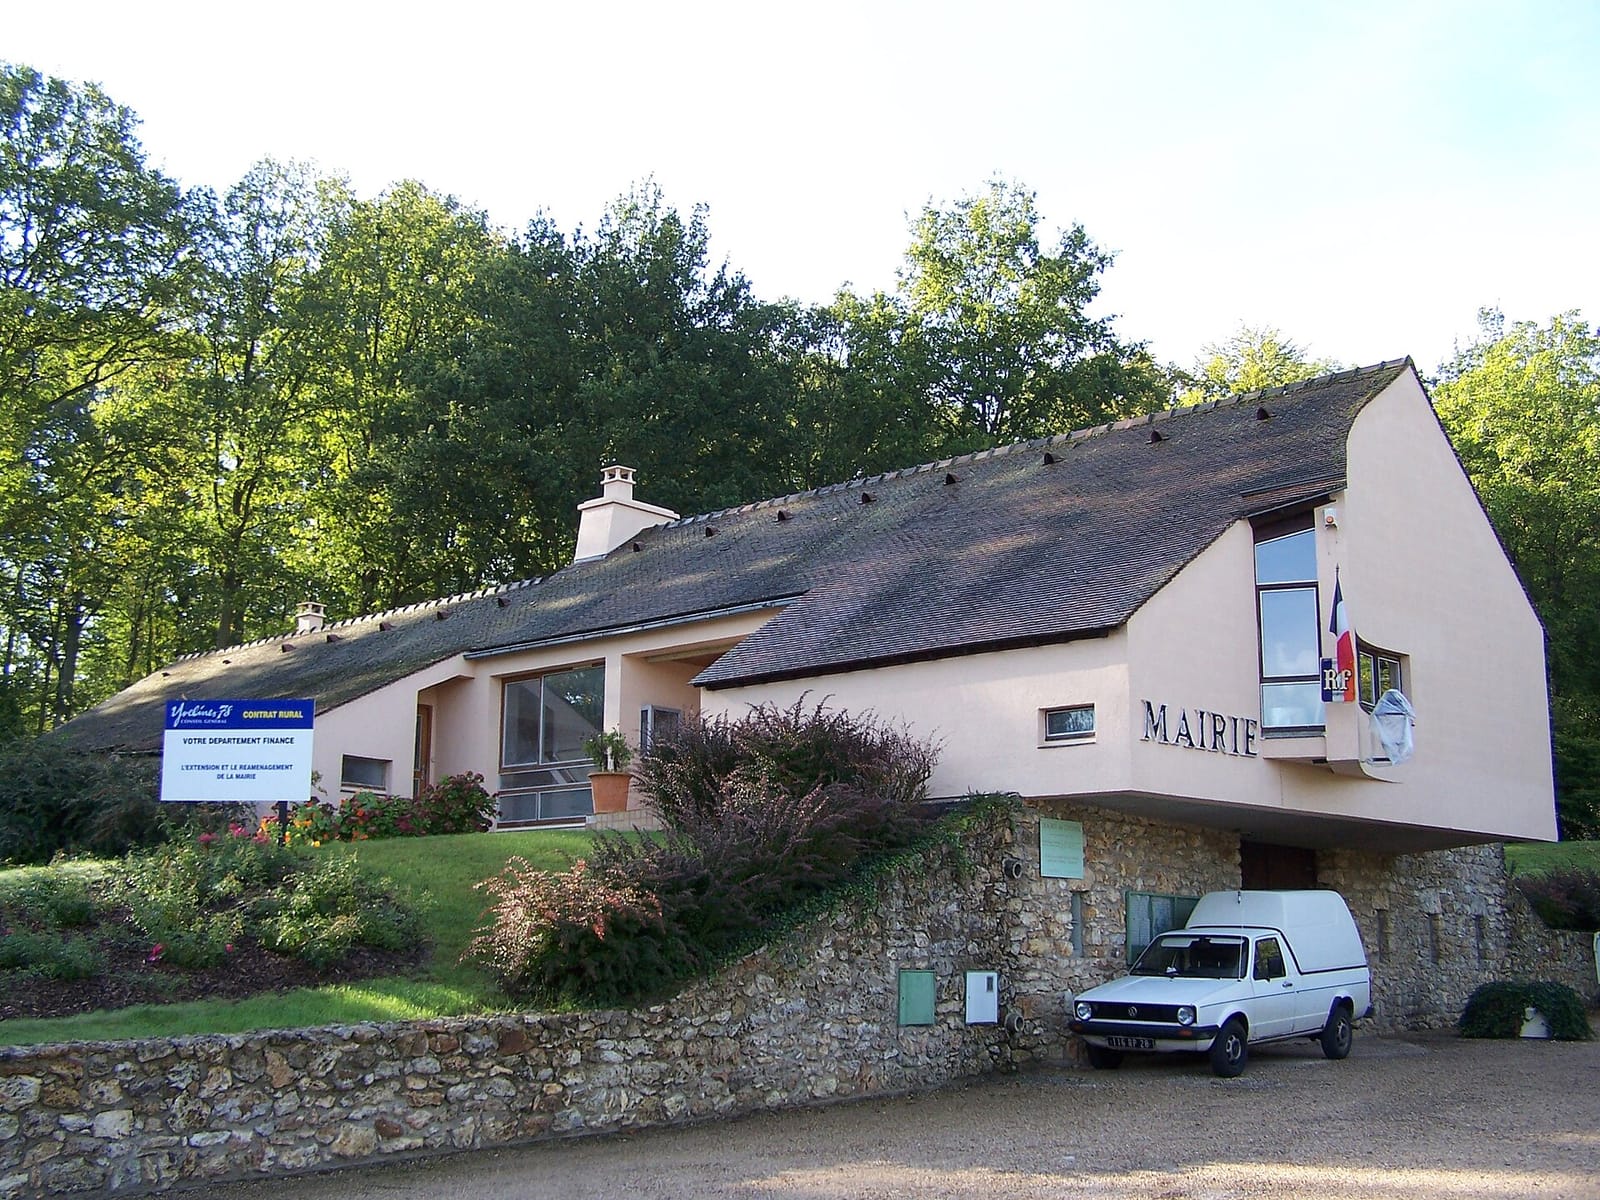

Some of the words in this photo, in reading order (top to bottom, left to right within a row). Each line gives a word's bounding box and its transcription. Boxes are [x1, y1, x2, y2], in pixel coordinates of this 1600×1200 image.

[216, 705, 234, 719] 78
[243, 711, 277, 719] CONTRAT
[278, 711, 304, 719] RURAL
[1140, 699, 1258, 758] MAIRIE
[182, 737, 207, 745] VOTRE
[208, 737, 261, 745] DEPARTEMENT
